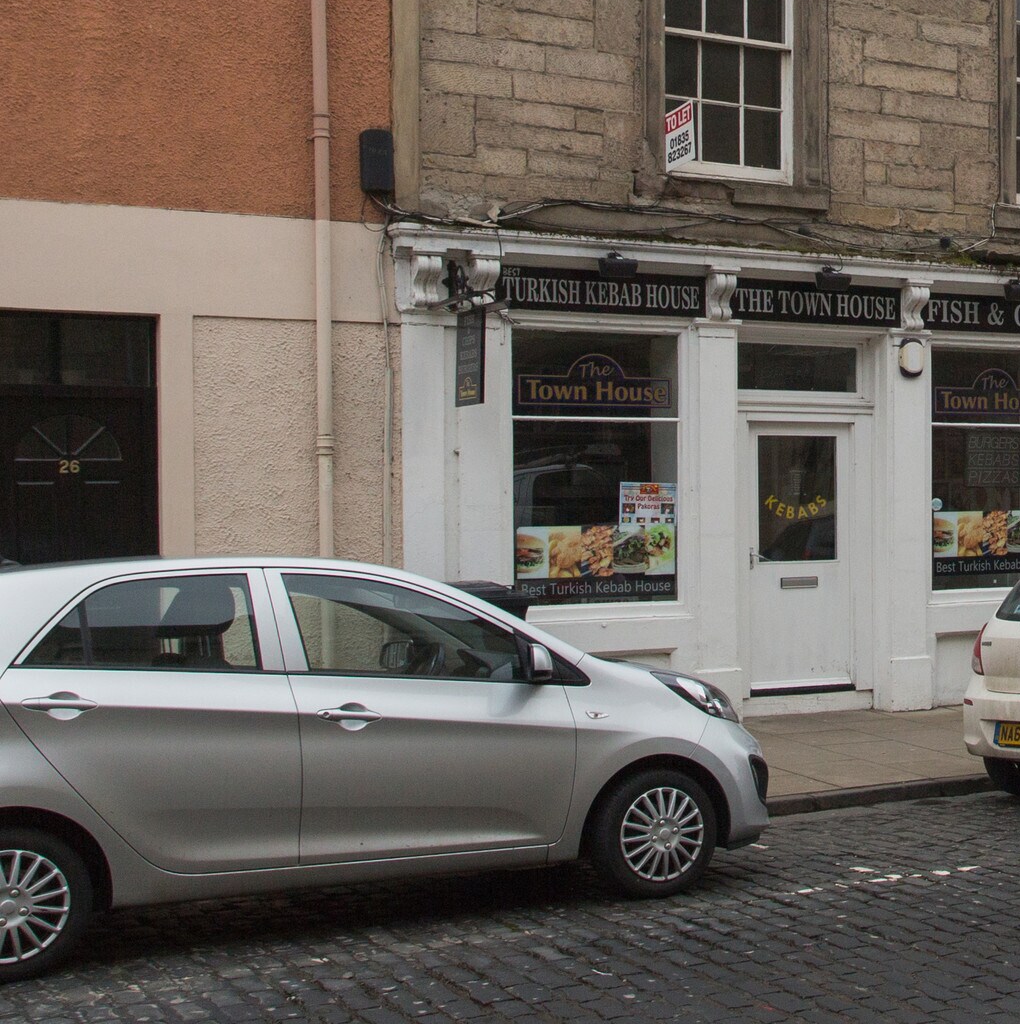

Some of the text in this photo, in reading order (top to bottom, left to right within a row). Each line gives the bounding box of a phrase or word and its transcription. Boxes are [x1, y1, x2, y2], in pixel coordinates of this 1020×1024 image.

[665, 106, 691, 132] TO LET
[670, 129, 689, 149] 01835
[667, 142, 691, 163] 823267
[502, 266, 521, 276] BEST
[502, 276, 700, 311] TURKISH KEBAB HOUSE
[735, 287, 897, 321] THE TOWN HOUSE
[927, 299, 981, 326] FISH
[986, 302, 1005, 326] &
[579, 361, 614, 378] The
[981, 374, 1008, 390] The
[526, 379, 667, 404] Town House
[941, 391, 988, 411] Town
[967, 436, 1020, 450] BURGERS
[58, 459, 81, 474] 26
[967, 453, 1020, 467] KEBABS
[967, 470, 1020, 485] PIZZAS
[623, 494, 673, 503] Try Our Delicious
[637, 502, 660, 510] Pakoras
[764, 494, 828, 520] KEBABS
[935, 560, 956, 573] Best
[958, 560, 991, 573] Turkish
[521, 580, 671, 596] Best Turkish Kebab House
